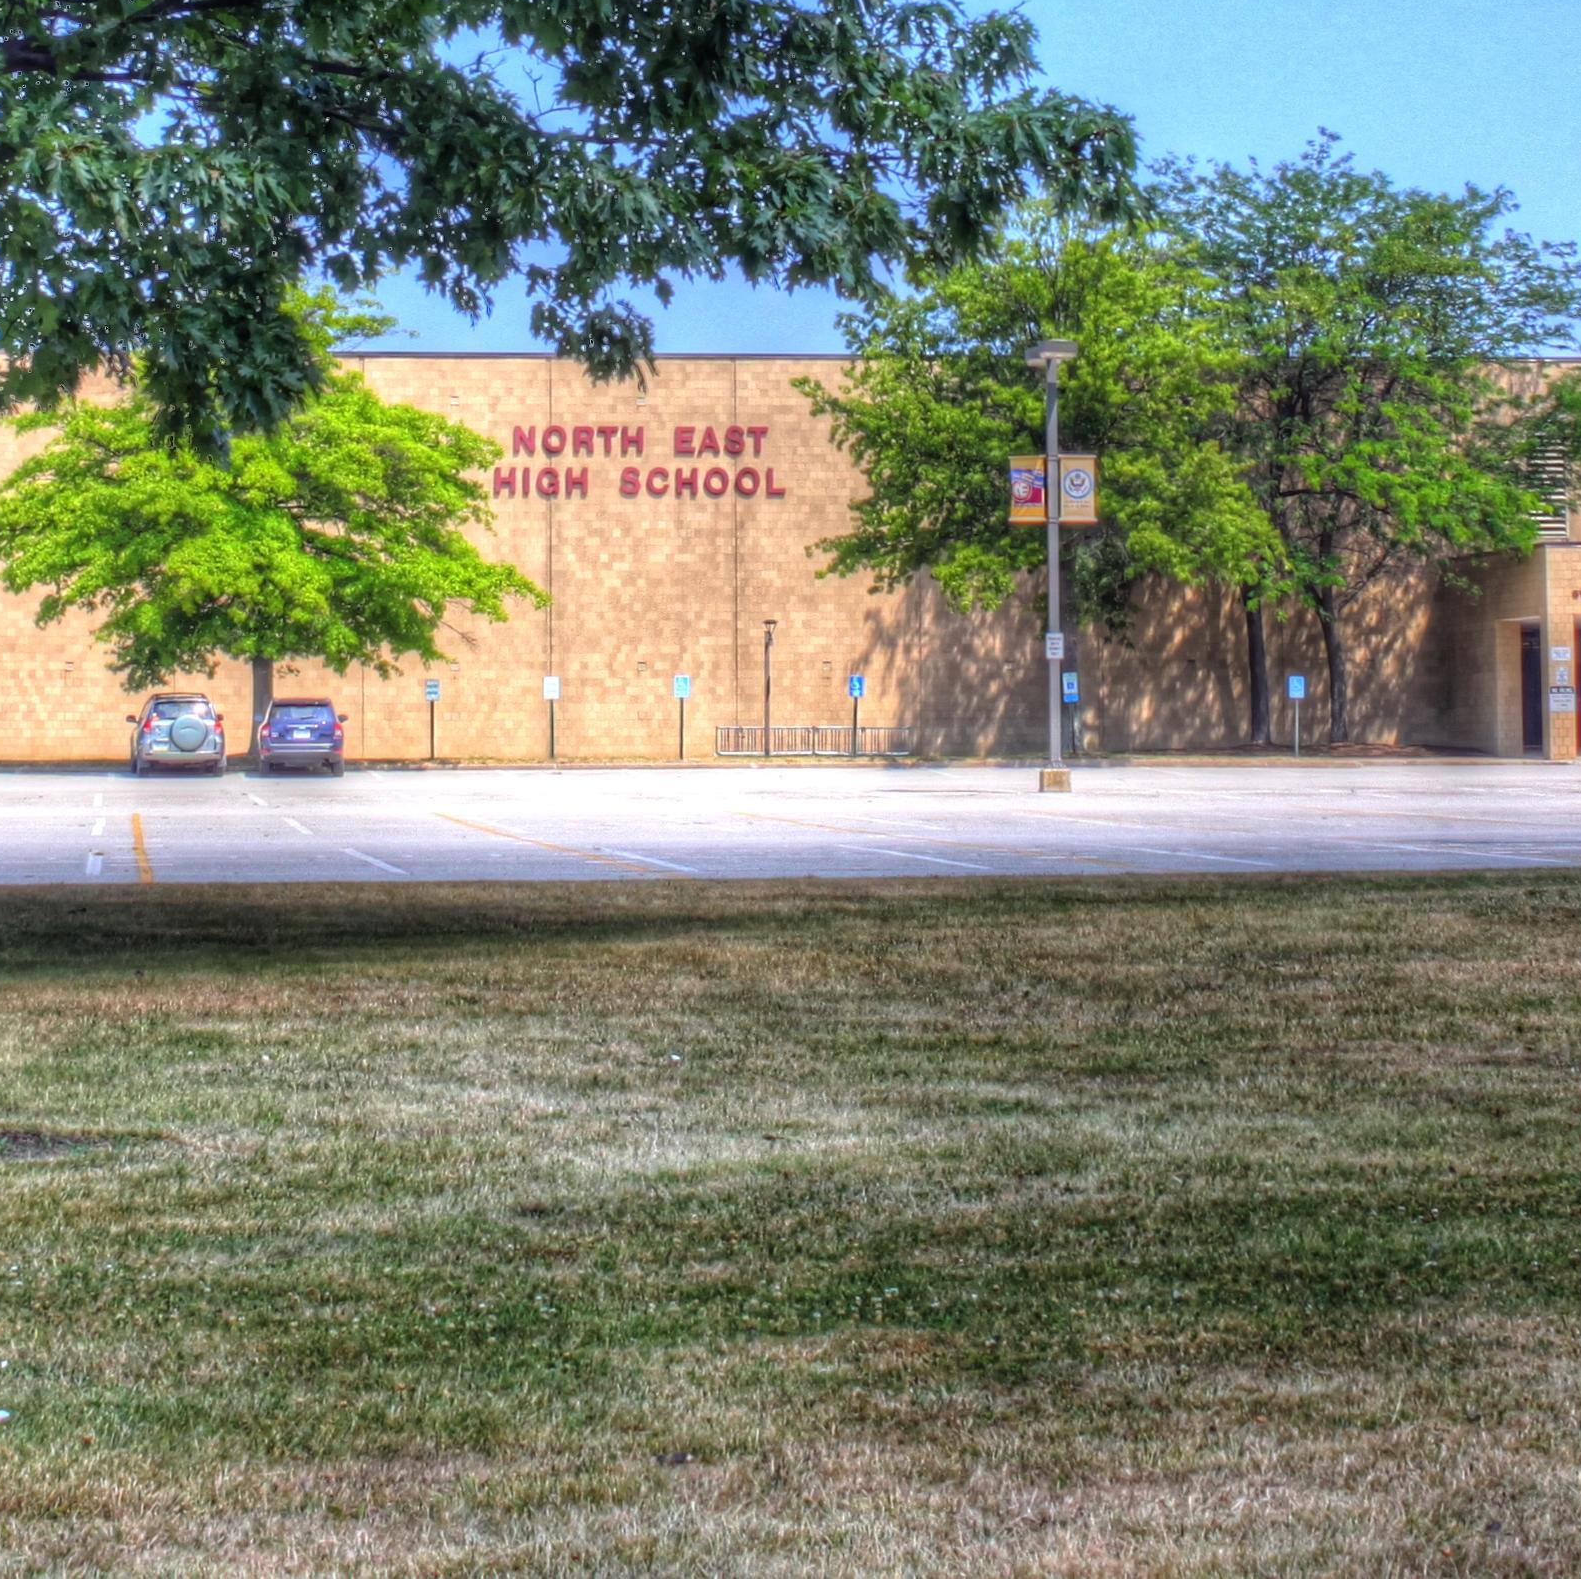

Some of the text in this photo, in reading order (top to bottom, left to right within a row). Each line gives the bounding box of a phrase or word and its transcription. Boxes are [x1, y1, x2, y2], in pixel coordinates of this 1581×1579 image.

[512, 425, 769, 455] NORTH EAST
[493, 467, 787, 497] HIGH SCHOOL
